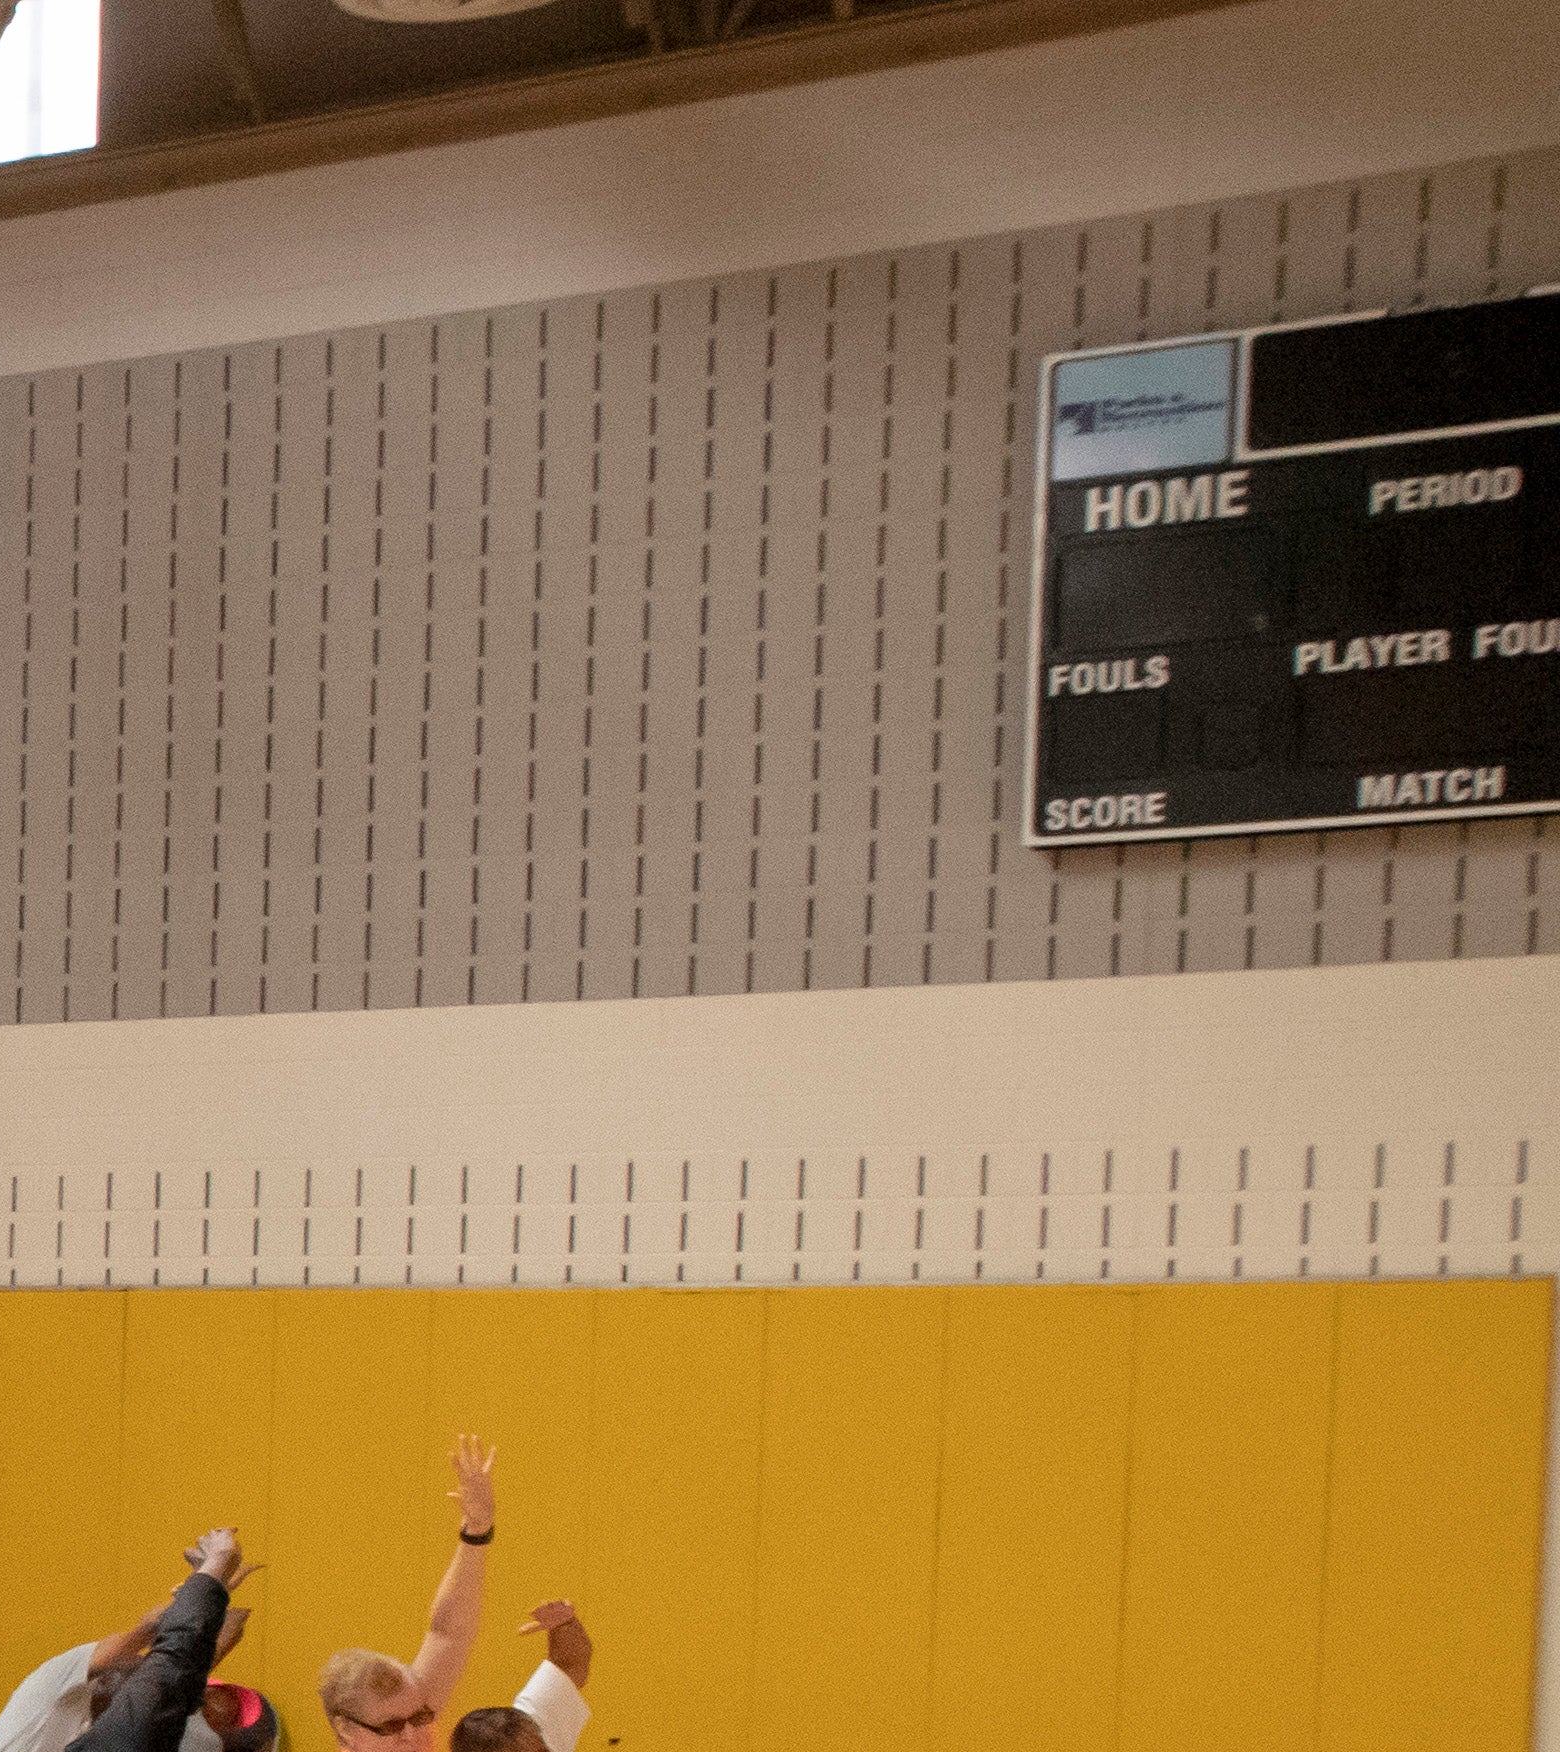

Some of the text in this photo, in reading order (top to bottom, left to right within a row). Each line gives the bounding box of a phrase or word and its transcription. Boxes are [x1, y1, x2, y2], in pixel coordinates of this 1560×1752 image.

[1084, 469, 1251, 533] HOME
[1369, 467, 1524, 515] PERIOD
[1293, 629, 1451, 677] PLAYER
[1047, 656, 1171, 698] FOULS
[1356, 765, 1506, 808] MATCH
[1044, 792, 1168, 831] SCORE
